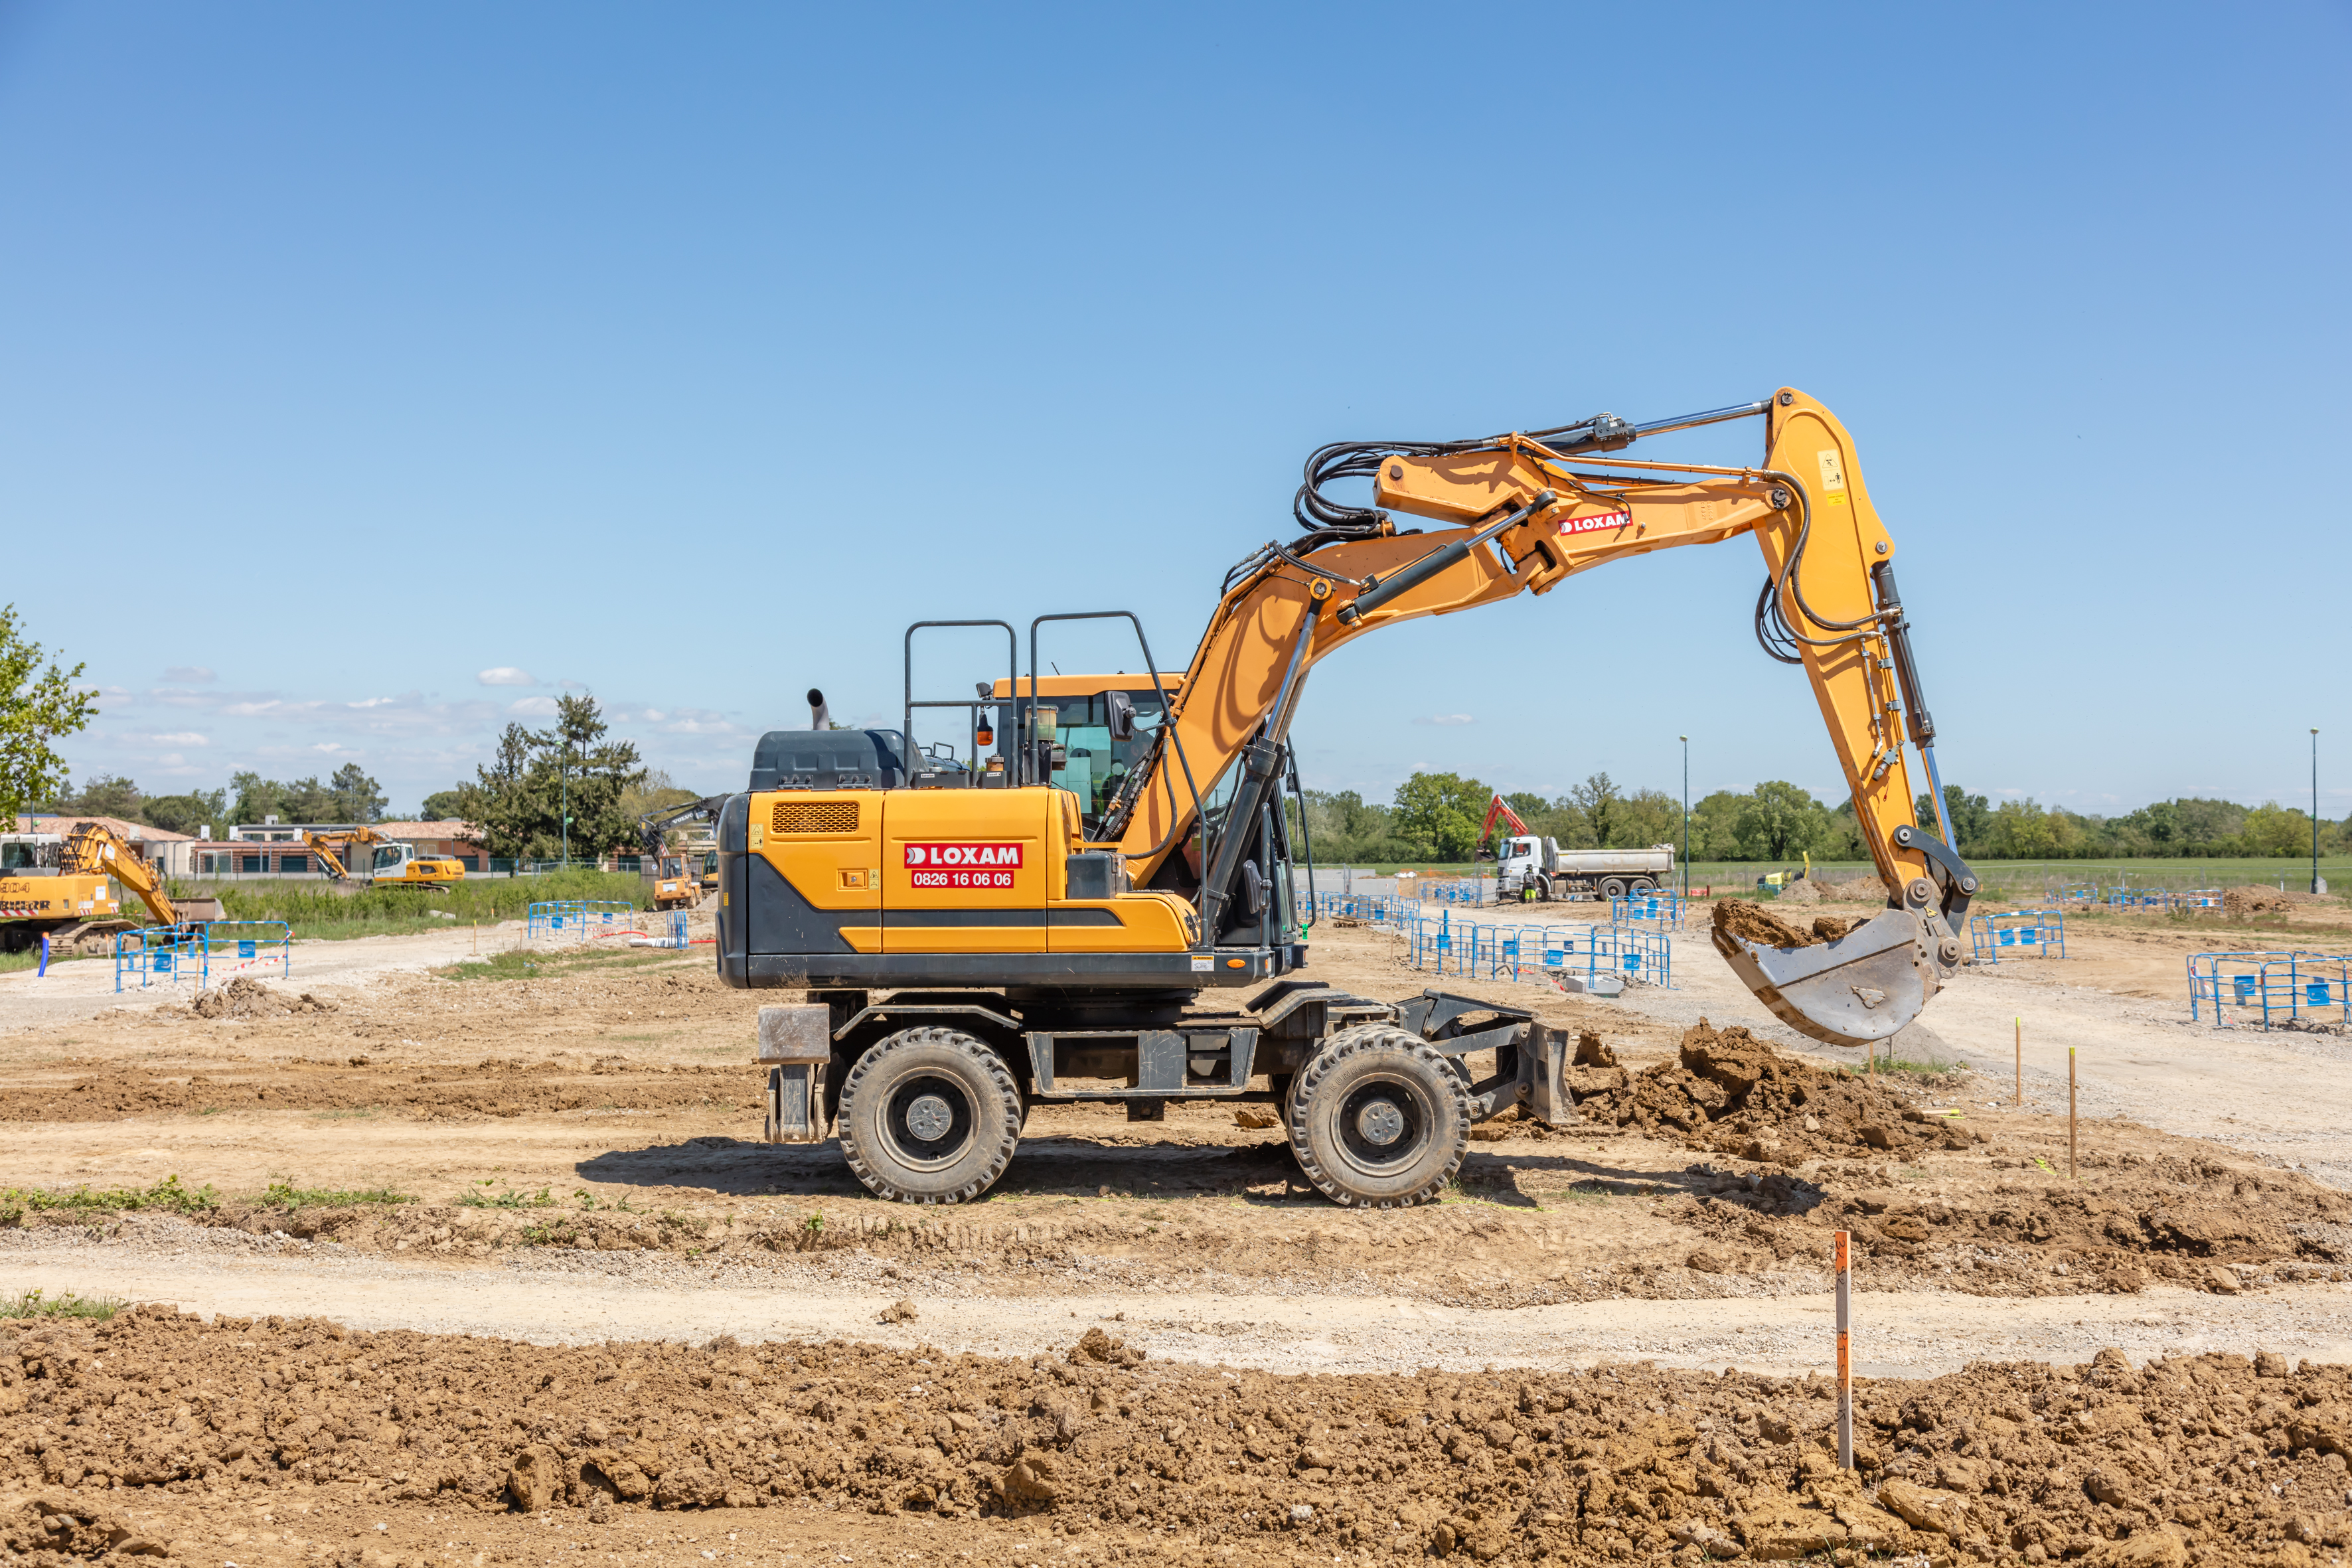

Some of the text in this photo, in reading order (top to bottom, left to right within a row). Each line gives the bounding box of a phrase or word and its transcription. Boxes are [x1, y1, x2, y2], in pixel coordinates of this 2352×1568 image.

[1574, 513, 1630, 531] LOXAM
[672, 813, 694, 824] VOLVO
[931, 847, 1019, 864] LOXAM
[913, 872, 1011, 886] 0826 16 06 06
[1328, 1063, 1366, 1092] KUMHO
[861, 1117, 880, 1160] KUMHO
